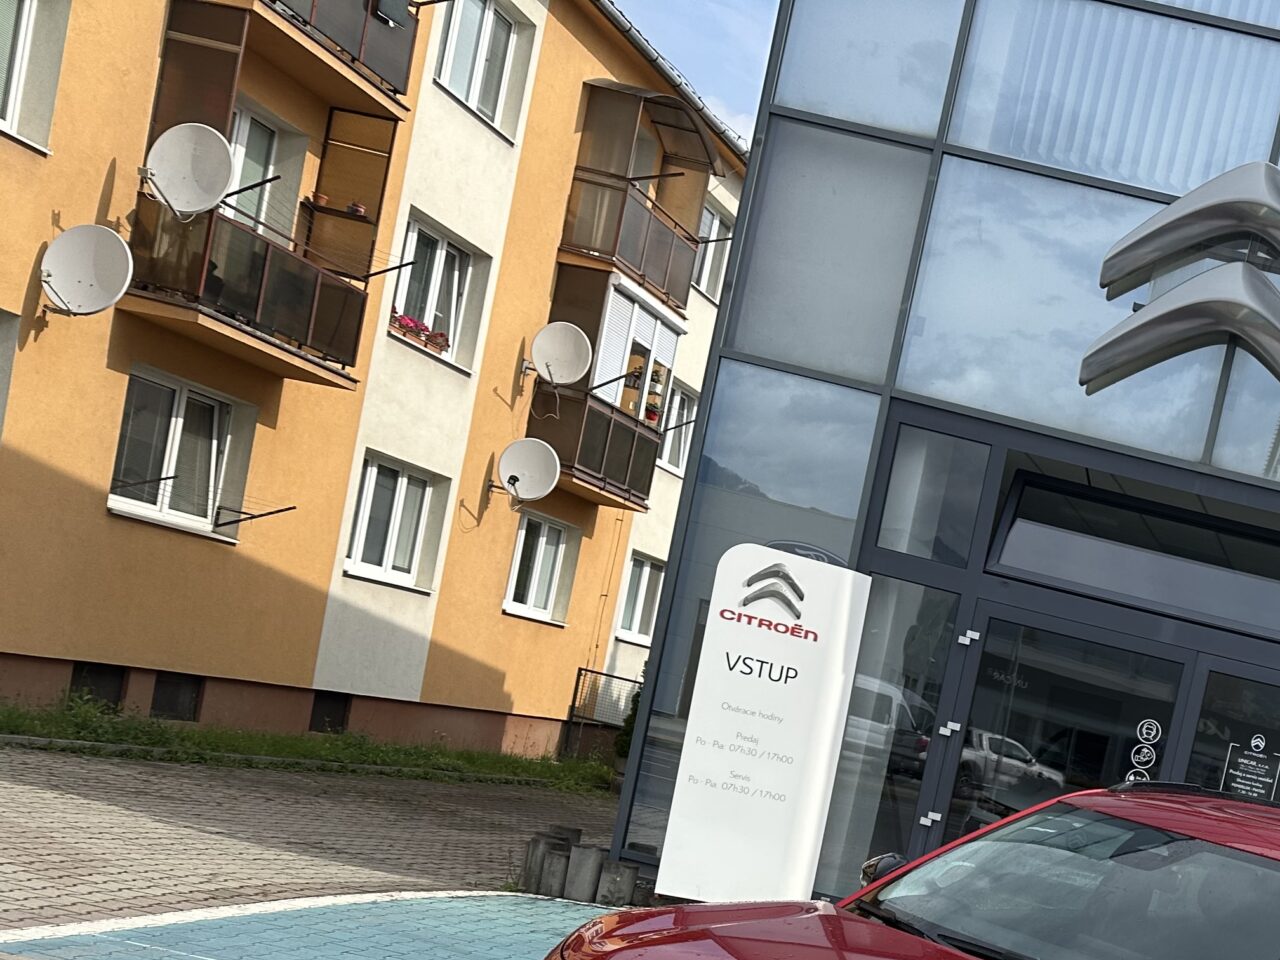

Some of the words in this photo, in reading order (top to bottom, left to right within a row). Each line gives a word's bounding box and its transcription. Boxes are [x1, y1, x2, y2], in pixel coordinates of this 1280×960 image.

[725, 651, 799, 685] VSTUP
[758, 709, 784, 724] hodiny
[736, 731, 759, 746] Predaj
[695, 736, 706, 746] Po
[729, 743, 757, 757] 07h30
[766, 751, 794, 764] 17h00
[729, 770, 751, 782] Servis
[688, 774, 699, 785] Po
[721, 782, 750, 795] 07h30
[759, 789, 786, 802] 17h00
